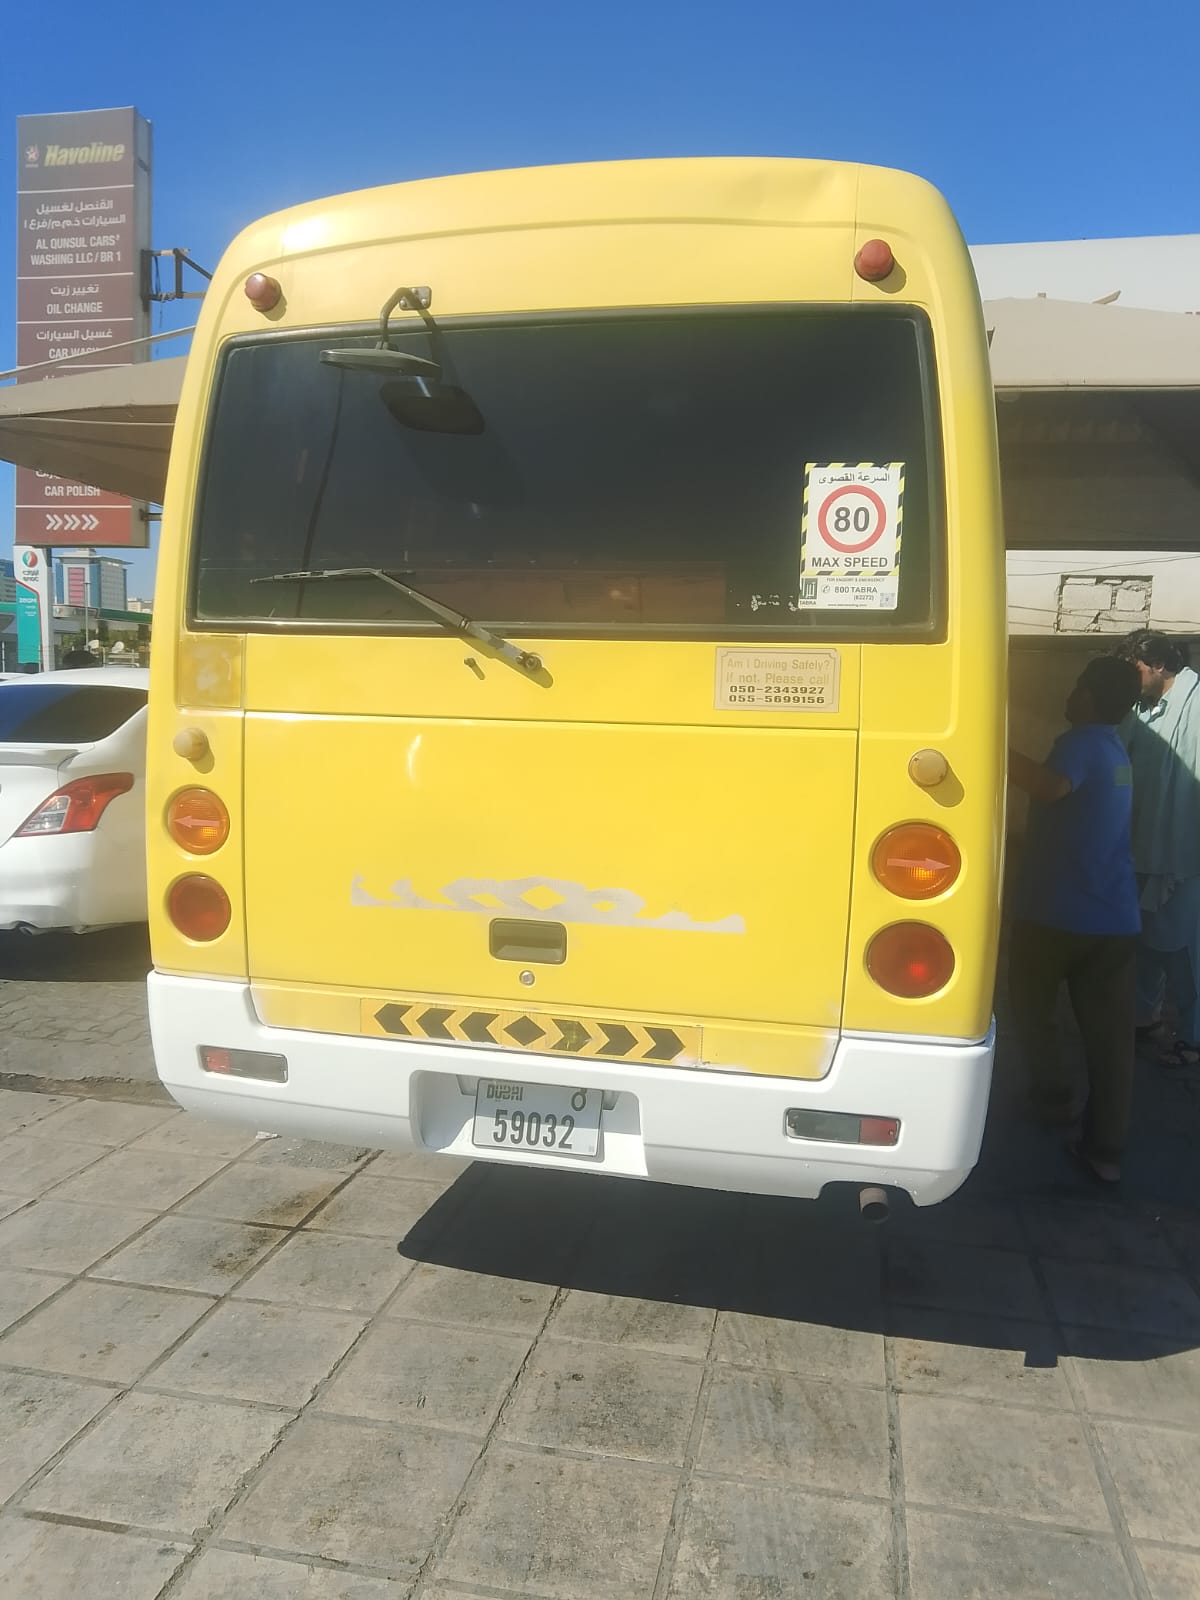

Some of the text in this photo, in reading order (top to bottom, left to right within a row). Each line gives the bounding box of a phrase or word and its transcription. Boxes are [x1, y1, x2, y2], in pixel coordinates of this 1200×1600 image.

[44, 141, 125, 167] Havoline
[82, 214, 126, 227] السيارات
[36, 238, 48, 250] AL
[50, 236, 88, 249] QUNSUL
[30, 253, 74, 266] WASHING
[100, 250, 114, 263] BR
[115, 250, 121, 262] 1
[50, 283, 99, 297] تغيير زيت
[46, 301, 103, 315] OIL CHANGE
[36, 328, 113, 342] غسيل السيارات
[48, 347, 69, 359] CAR
[818, 472, 890, 484] السرعة القصوى
[44, 485, 101, 497] CAR POLISH
[834, 506, 870, 532] 80
[811, 557, 888, 568] MAX SPEED
[834, 586, 878, 594] 800 TABRA
[727, 658, 744, 669] Am
[753, 659, 788, 671] Driving
[791, 659, 830, 672] Safely?
[765, 673, 804, 684] Please
[809, 674, 830, 685] call
[729, 685, 825, 695] 050-2343927
[728, 695, 826, 704] 055-5699156
[486, 1082, 524, 1102] DUBAI
[492, 1108, 576, 1150] 59032
